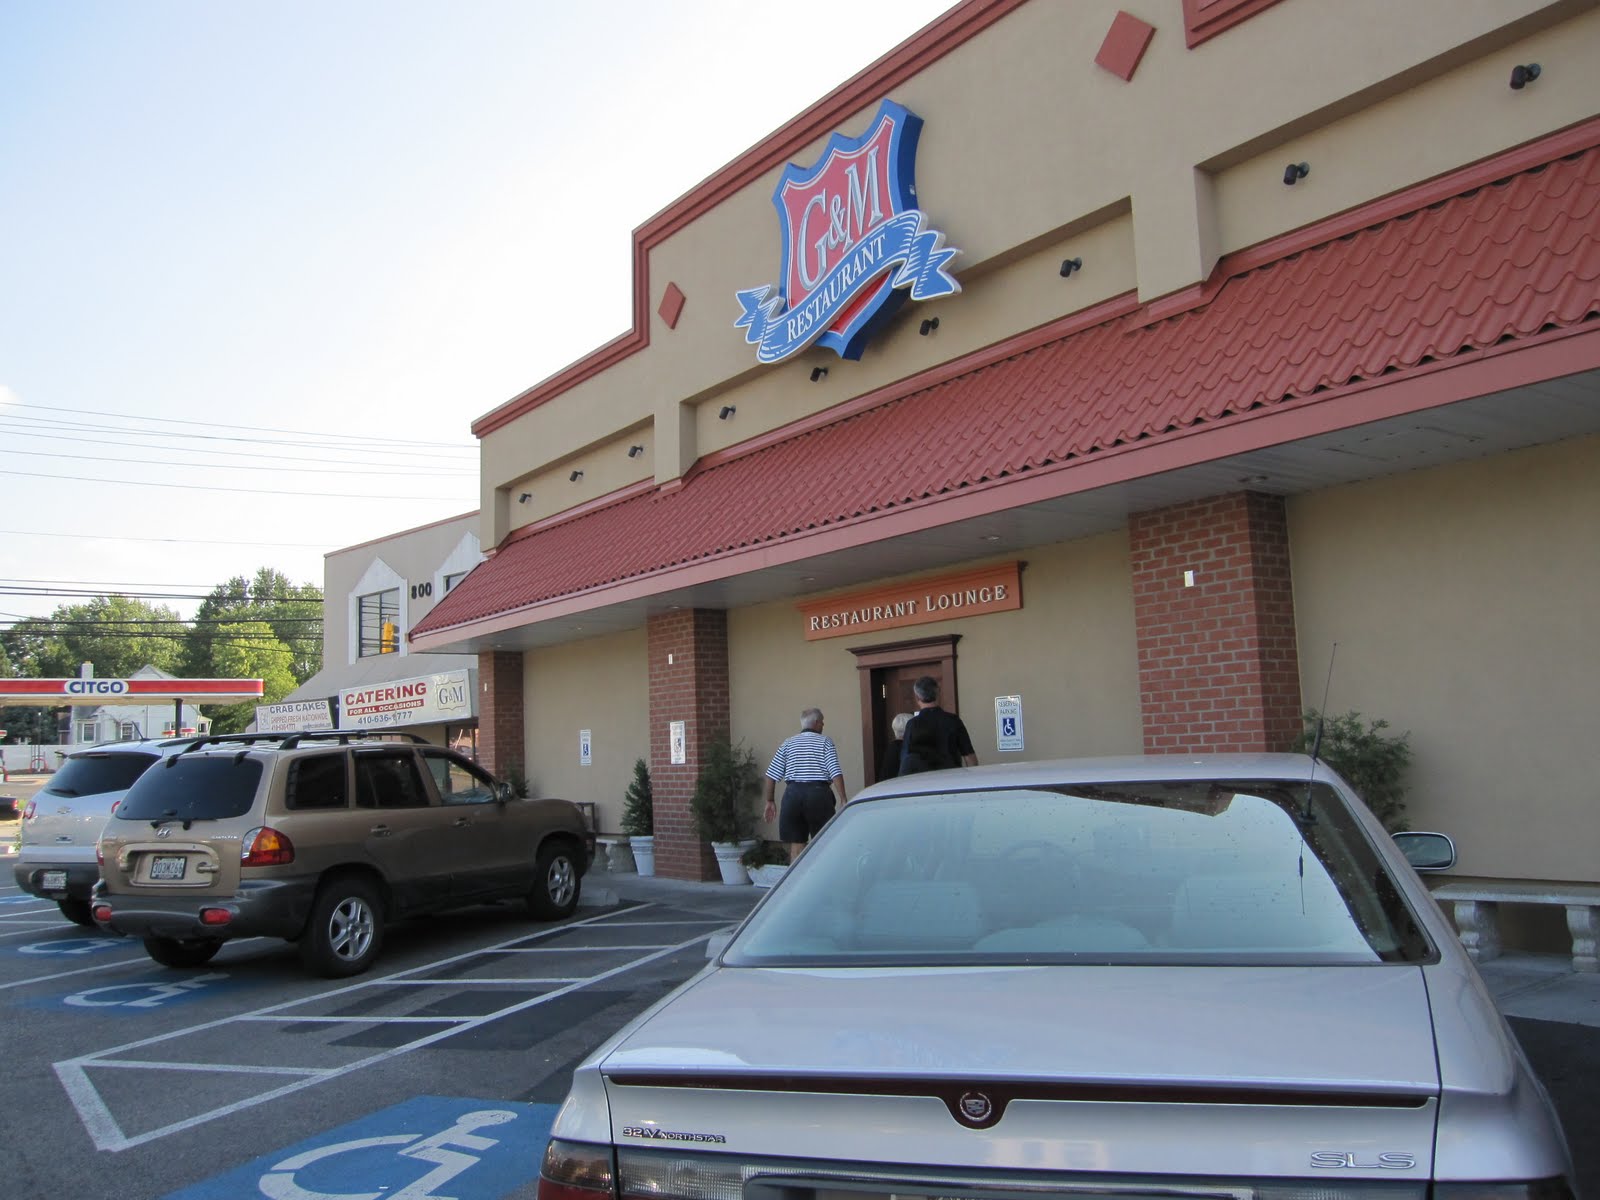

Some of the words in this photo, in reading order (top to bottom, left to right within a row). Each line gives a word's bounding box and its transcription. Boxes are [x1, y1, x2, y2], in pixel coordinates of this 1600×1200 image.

[798, 146, 883, 291] G&M
[787, 233, 886, 344] RESTAURANT
[411, 582, 432, 599] 800
[810, 601, 917, 631] RESTAURANT
[926, 585, 1008, 612] LOUNGE
[69, 681, 124, 694] CITGO
[345, 682, 427, 706] CATERING
[438, 685, 464, 705] G&M
[270, 704, 293, 713] CRAB
[295, 702, 326, 711] CAKES
[349, 708, 363, 716] FOR
[364, 705, 377, 713] ALL
[379, 700, 422, 712] OCCASIONS
[660, 1131, 726, 1144] NORTHSTAR
[1310, 1151, 1416, 1170] SLS
